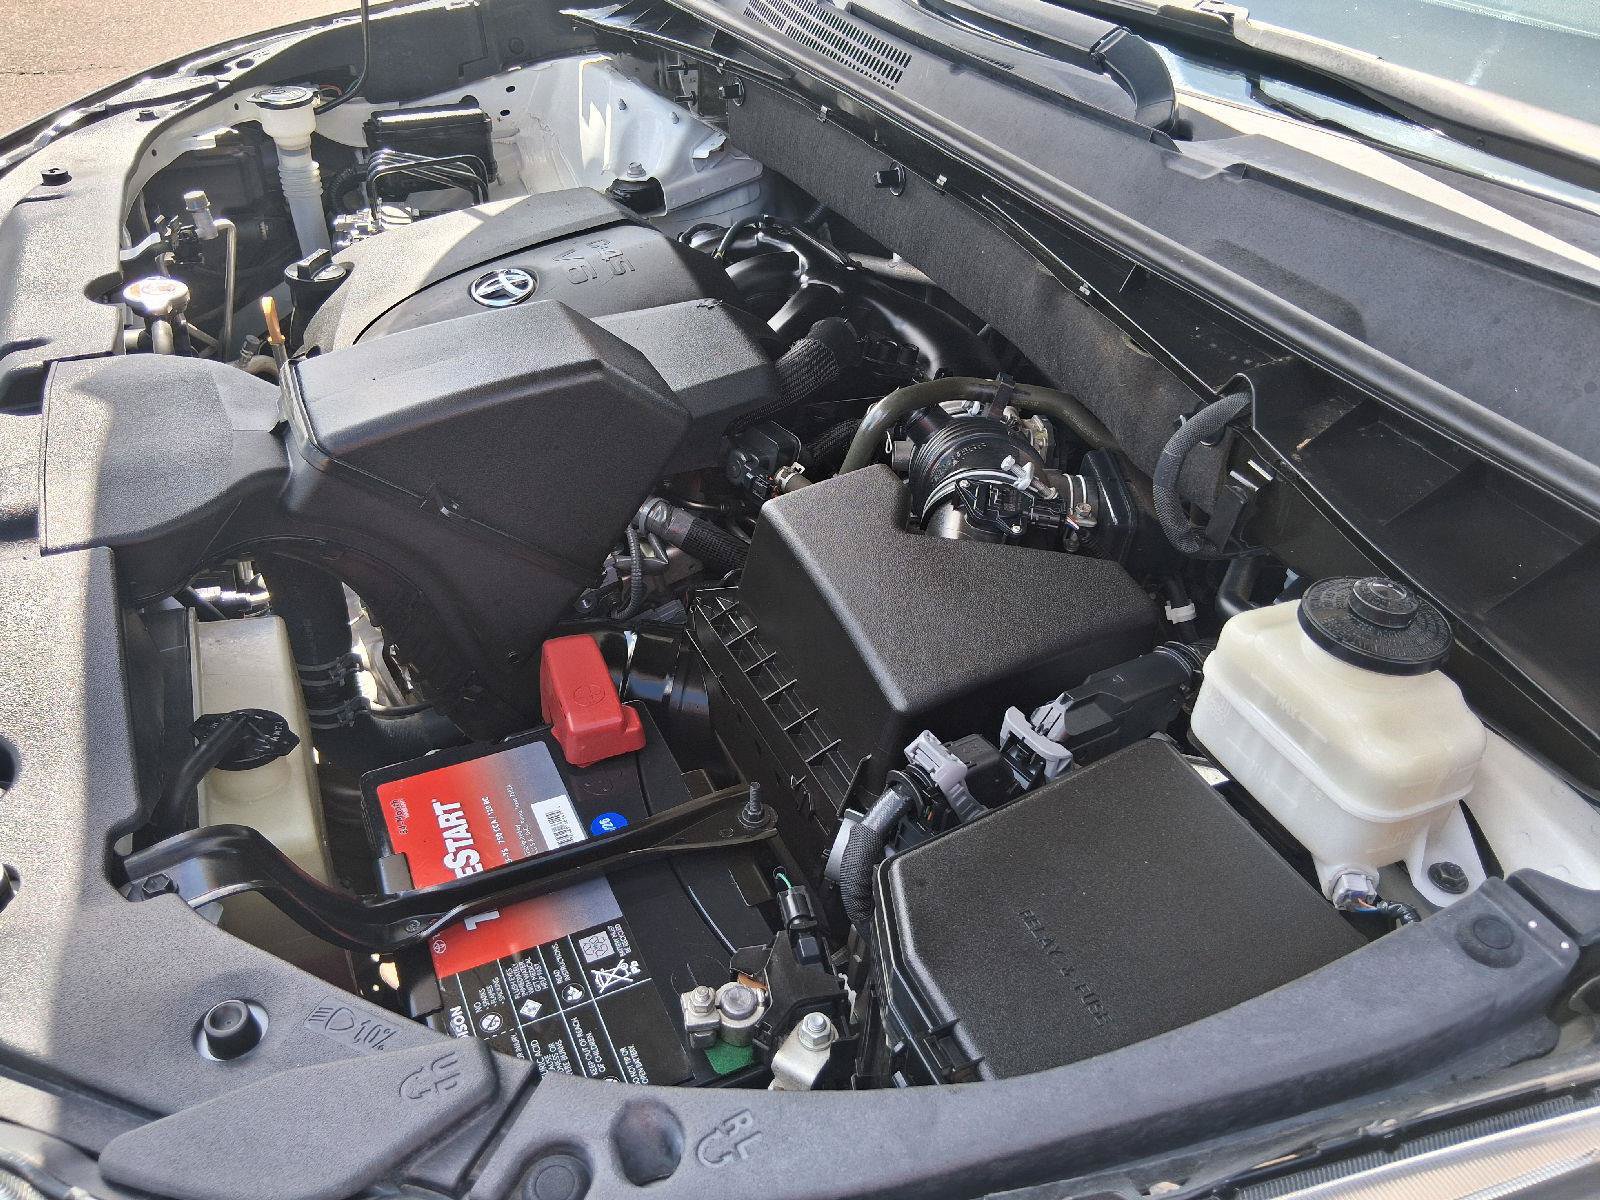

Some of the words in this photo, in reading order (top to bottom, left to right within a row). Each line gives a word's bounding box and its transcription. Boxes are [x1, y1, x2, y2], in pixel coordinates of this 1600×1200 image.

[614, 923, 629, 946] RECYCLED
[612, 938, 627, 958] BATTERY
[506, 967, 515, 981] EYES
[629, 960, 641, 974] Pb
[1017, 908, 1068, 961] RELAY
[1074, 983, 1113, 1028] FUSE
[511, 962, 528, 998] IMMEDIATELY
[553, 969, 563, 984] READ
[509, 980, 521, 1000] FLUSH
[474, 1001, 483, 1014] NO
[570, 1016, 584, 1038] REACH
[530, 1039, 542, 1057] ACID
[548, 1042, 557, 1053] OR
[578, 1037, 588, 1047] OF
[581, 1046, 593, 1061] OUT
[619, 1046, 629, 1057] OR
[587, 1060, 599, 1076] KEEP
[596, 1063, 606, 1073] OF
[627, 1065, 638, 1078] NOT
[637, 1067, 649, 1084] OPEN
